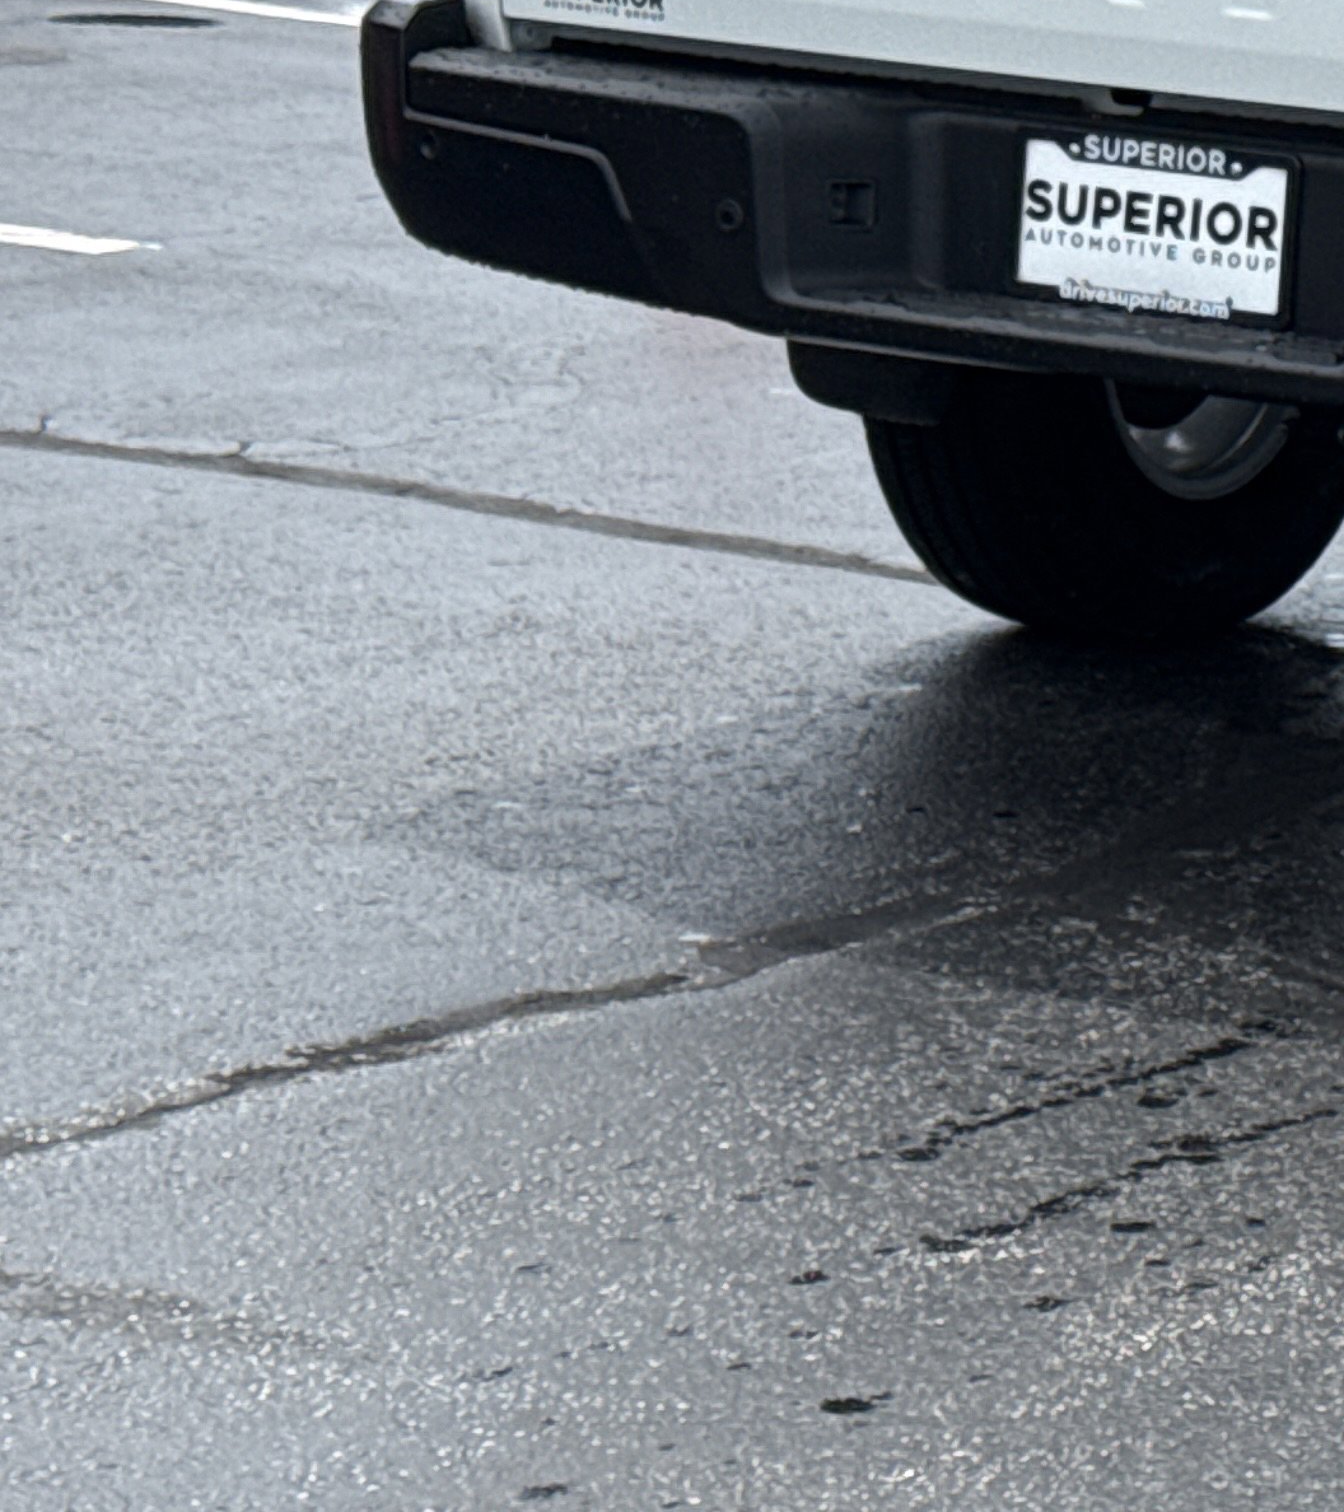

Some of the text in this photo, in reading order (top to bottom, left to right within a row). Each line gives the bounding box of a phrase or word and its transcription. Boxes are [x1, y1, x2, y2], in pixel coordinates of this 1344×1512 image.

[1083, 134, 1227, 177] SUPERIOR
[1025, 179, 1278, 251] SUPERIOR
[1024, 227, 1278, 273] AUTOMOTIVE GROUP
[1058, 278, 1231, 321] drivesuperior.com
